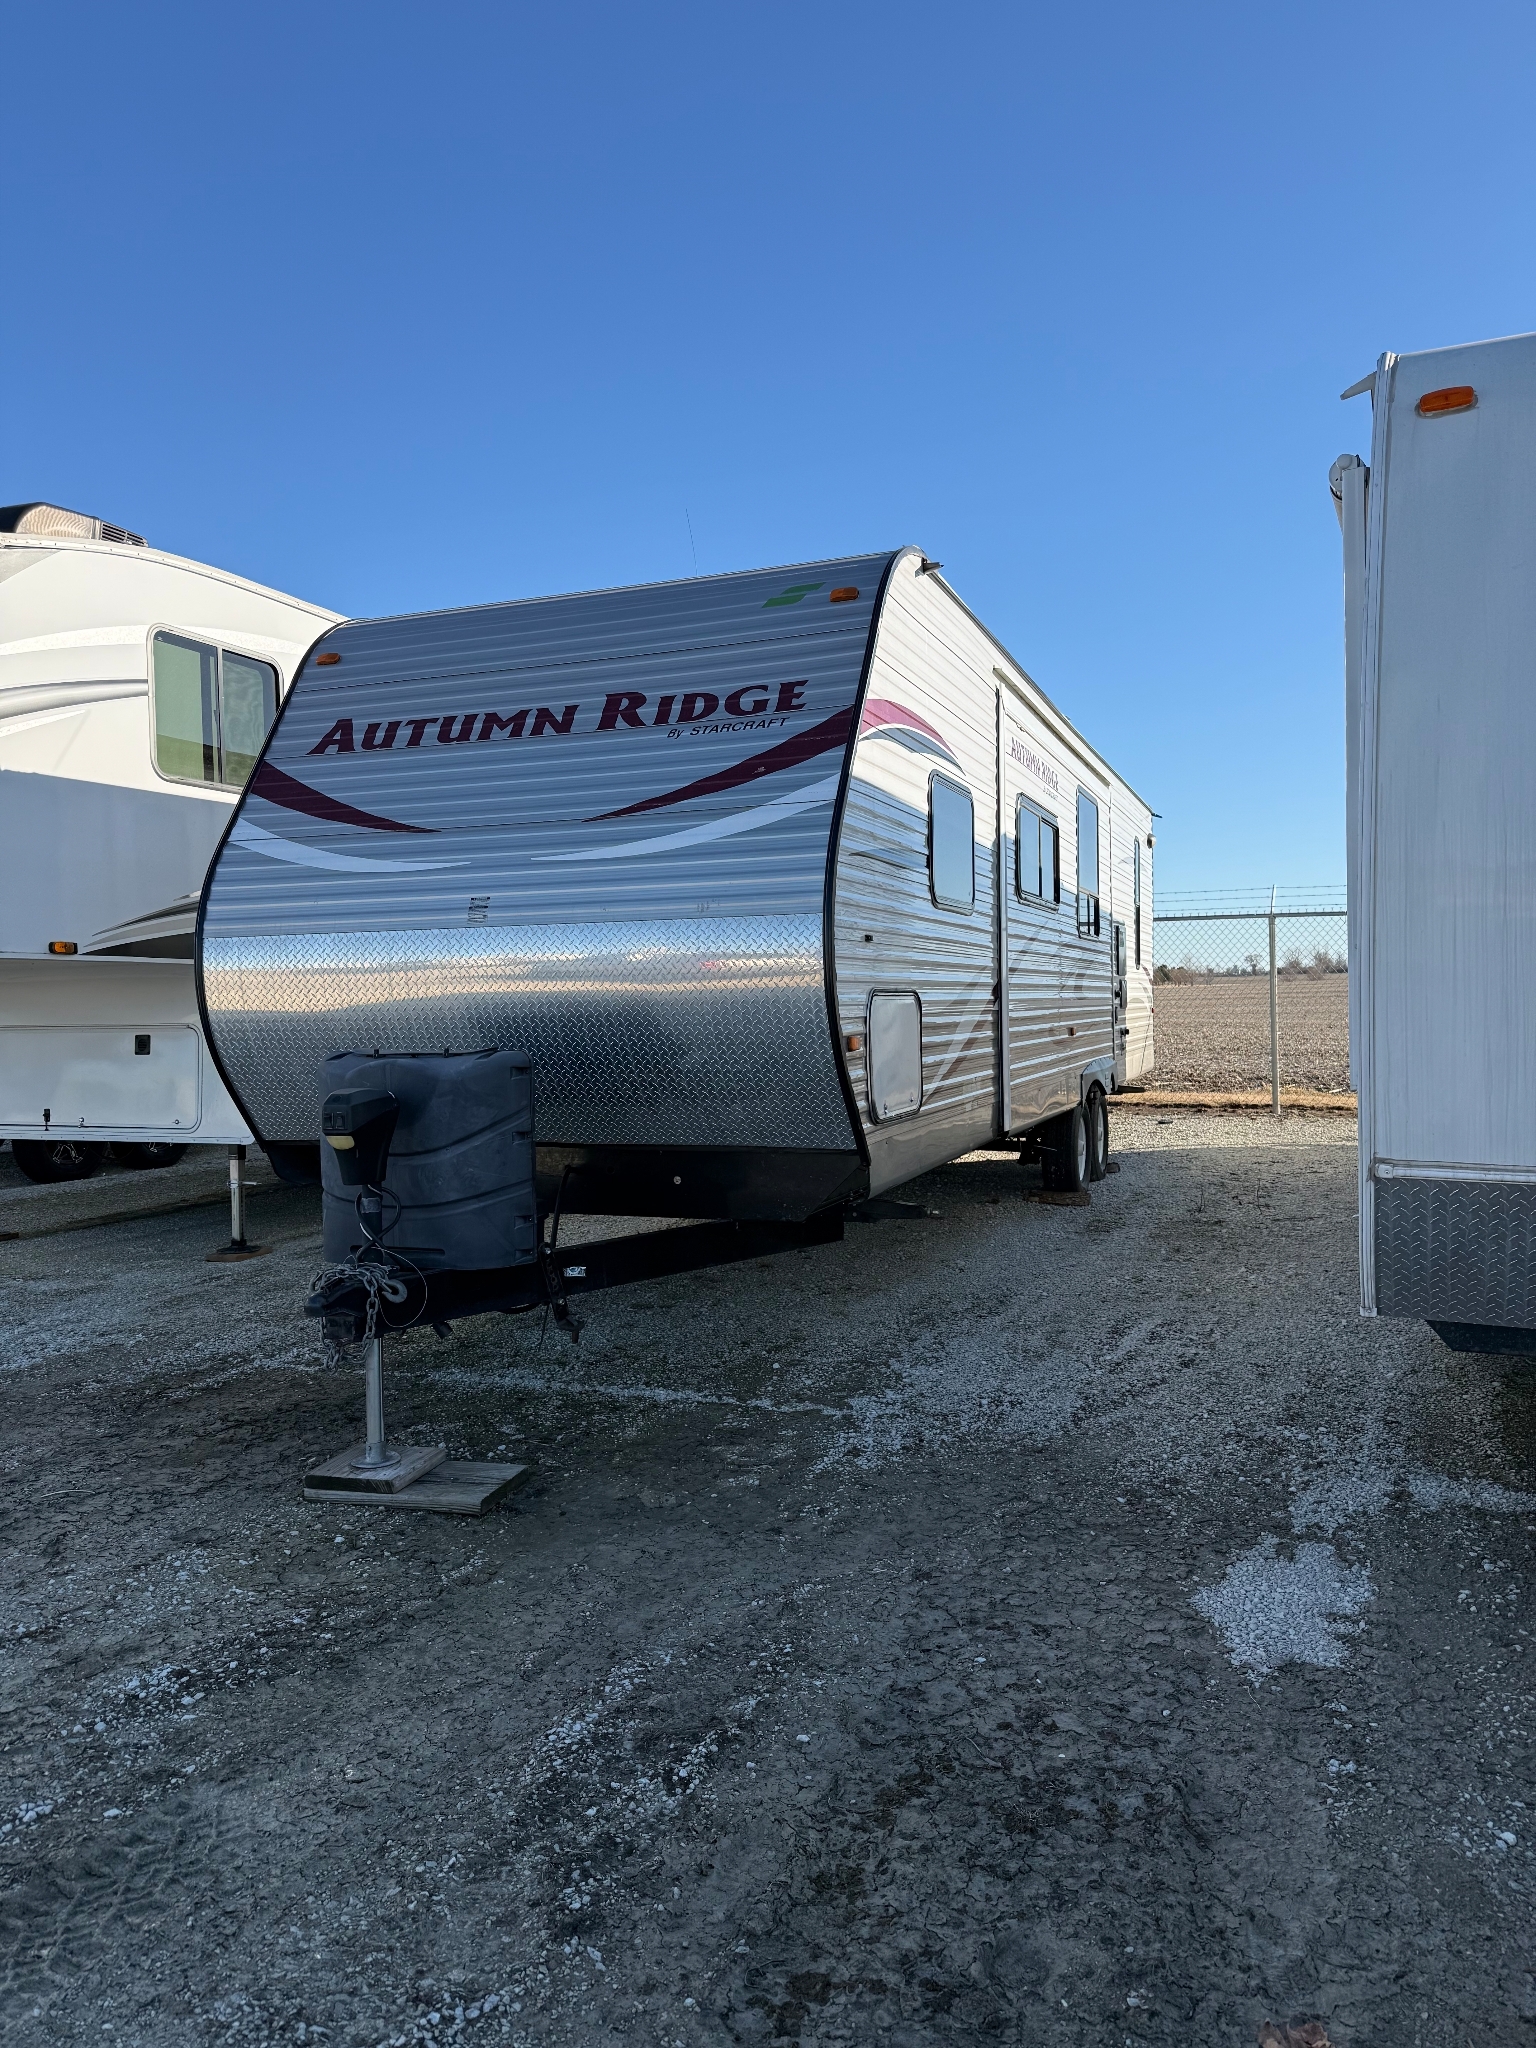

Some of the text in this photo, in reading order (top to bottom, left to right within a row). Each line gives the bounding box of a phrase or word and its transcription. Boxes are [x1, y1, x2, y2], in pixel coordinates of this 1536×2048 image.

[305, 680, 809, 755] AUTUMN RIDGE
[667, 717, 790, 739] By STARCRAFT
